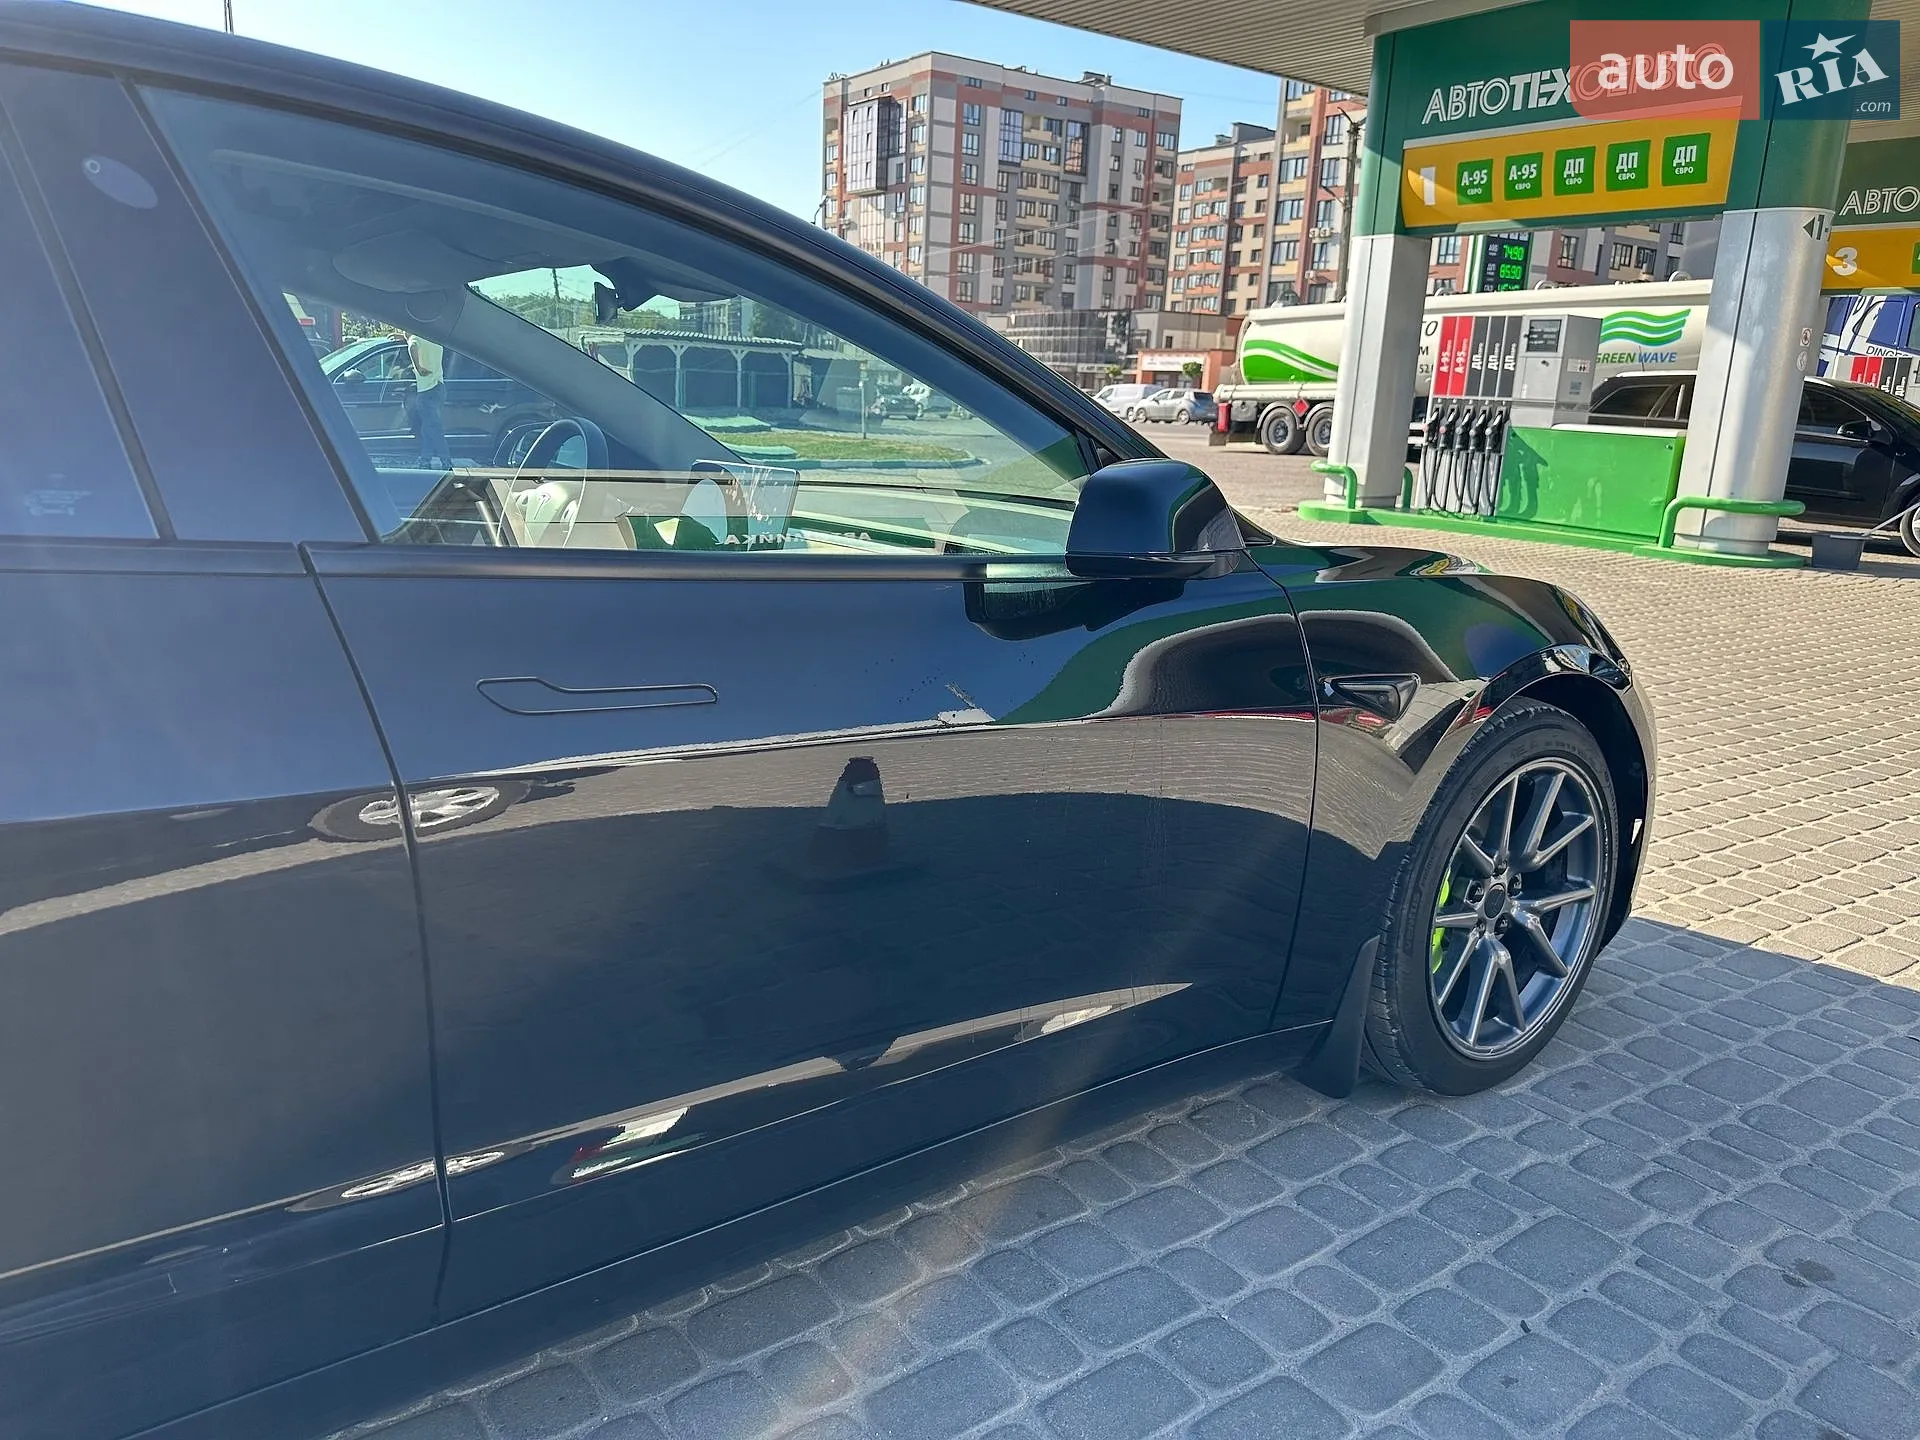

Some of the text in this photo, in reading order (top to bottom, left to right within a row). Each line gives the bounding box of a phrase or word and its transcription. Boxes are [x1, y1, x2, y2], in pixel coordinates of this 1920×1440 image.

[1616, 152, 1639, 173] ДП
[1672, 145, 1697, 167] ДП
[1461, 169, 1488, 187] А-95
[1509, 163, 1537, 180] А-95
[1563, 157, 1585, 178] ДП
[1420, 166, 1436, 206] 1
[1838, 185, 1920, 216] АВТО
[1832, 246, 1858, 276] 3
[1596, 351, 1678, 363] GREEN WAVE
